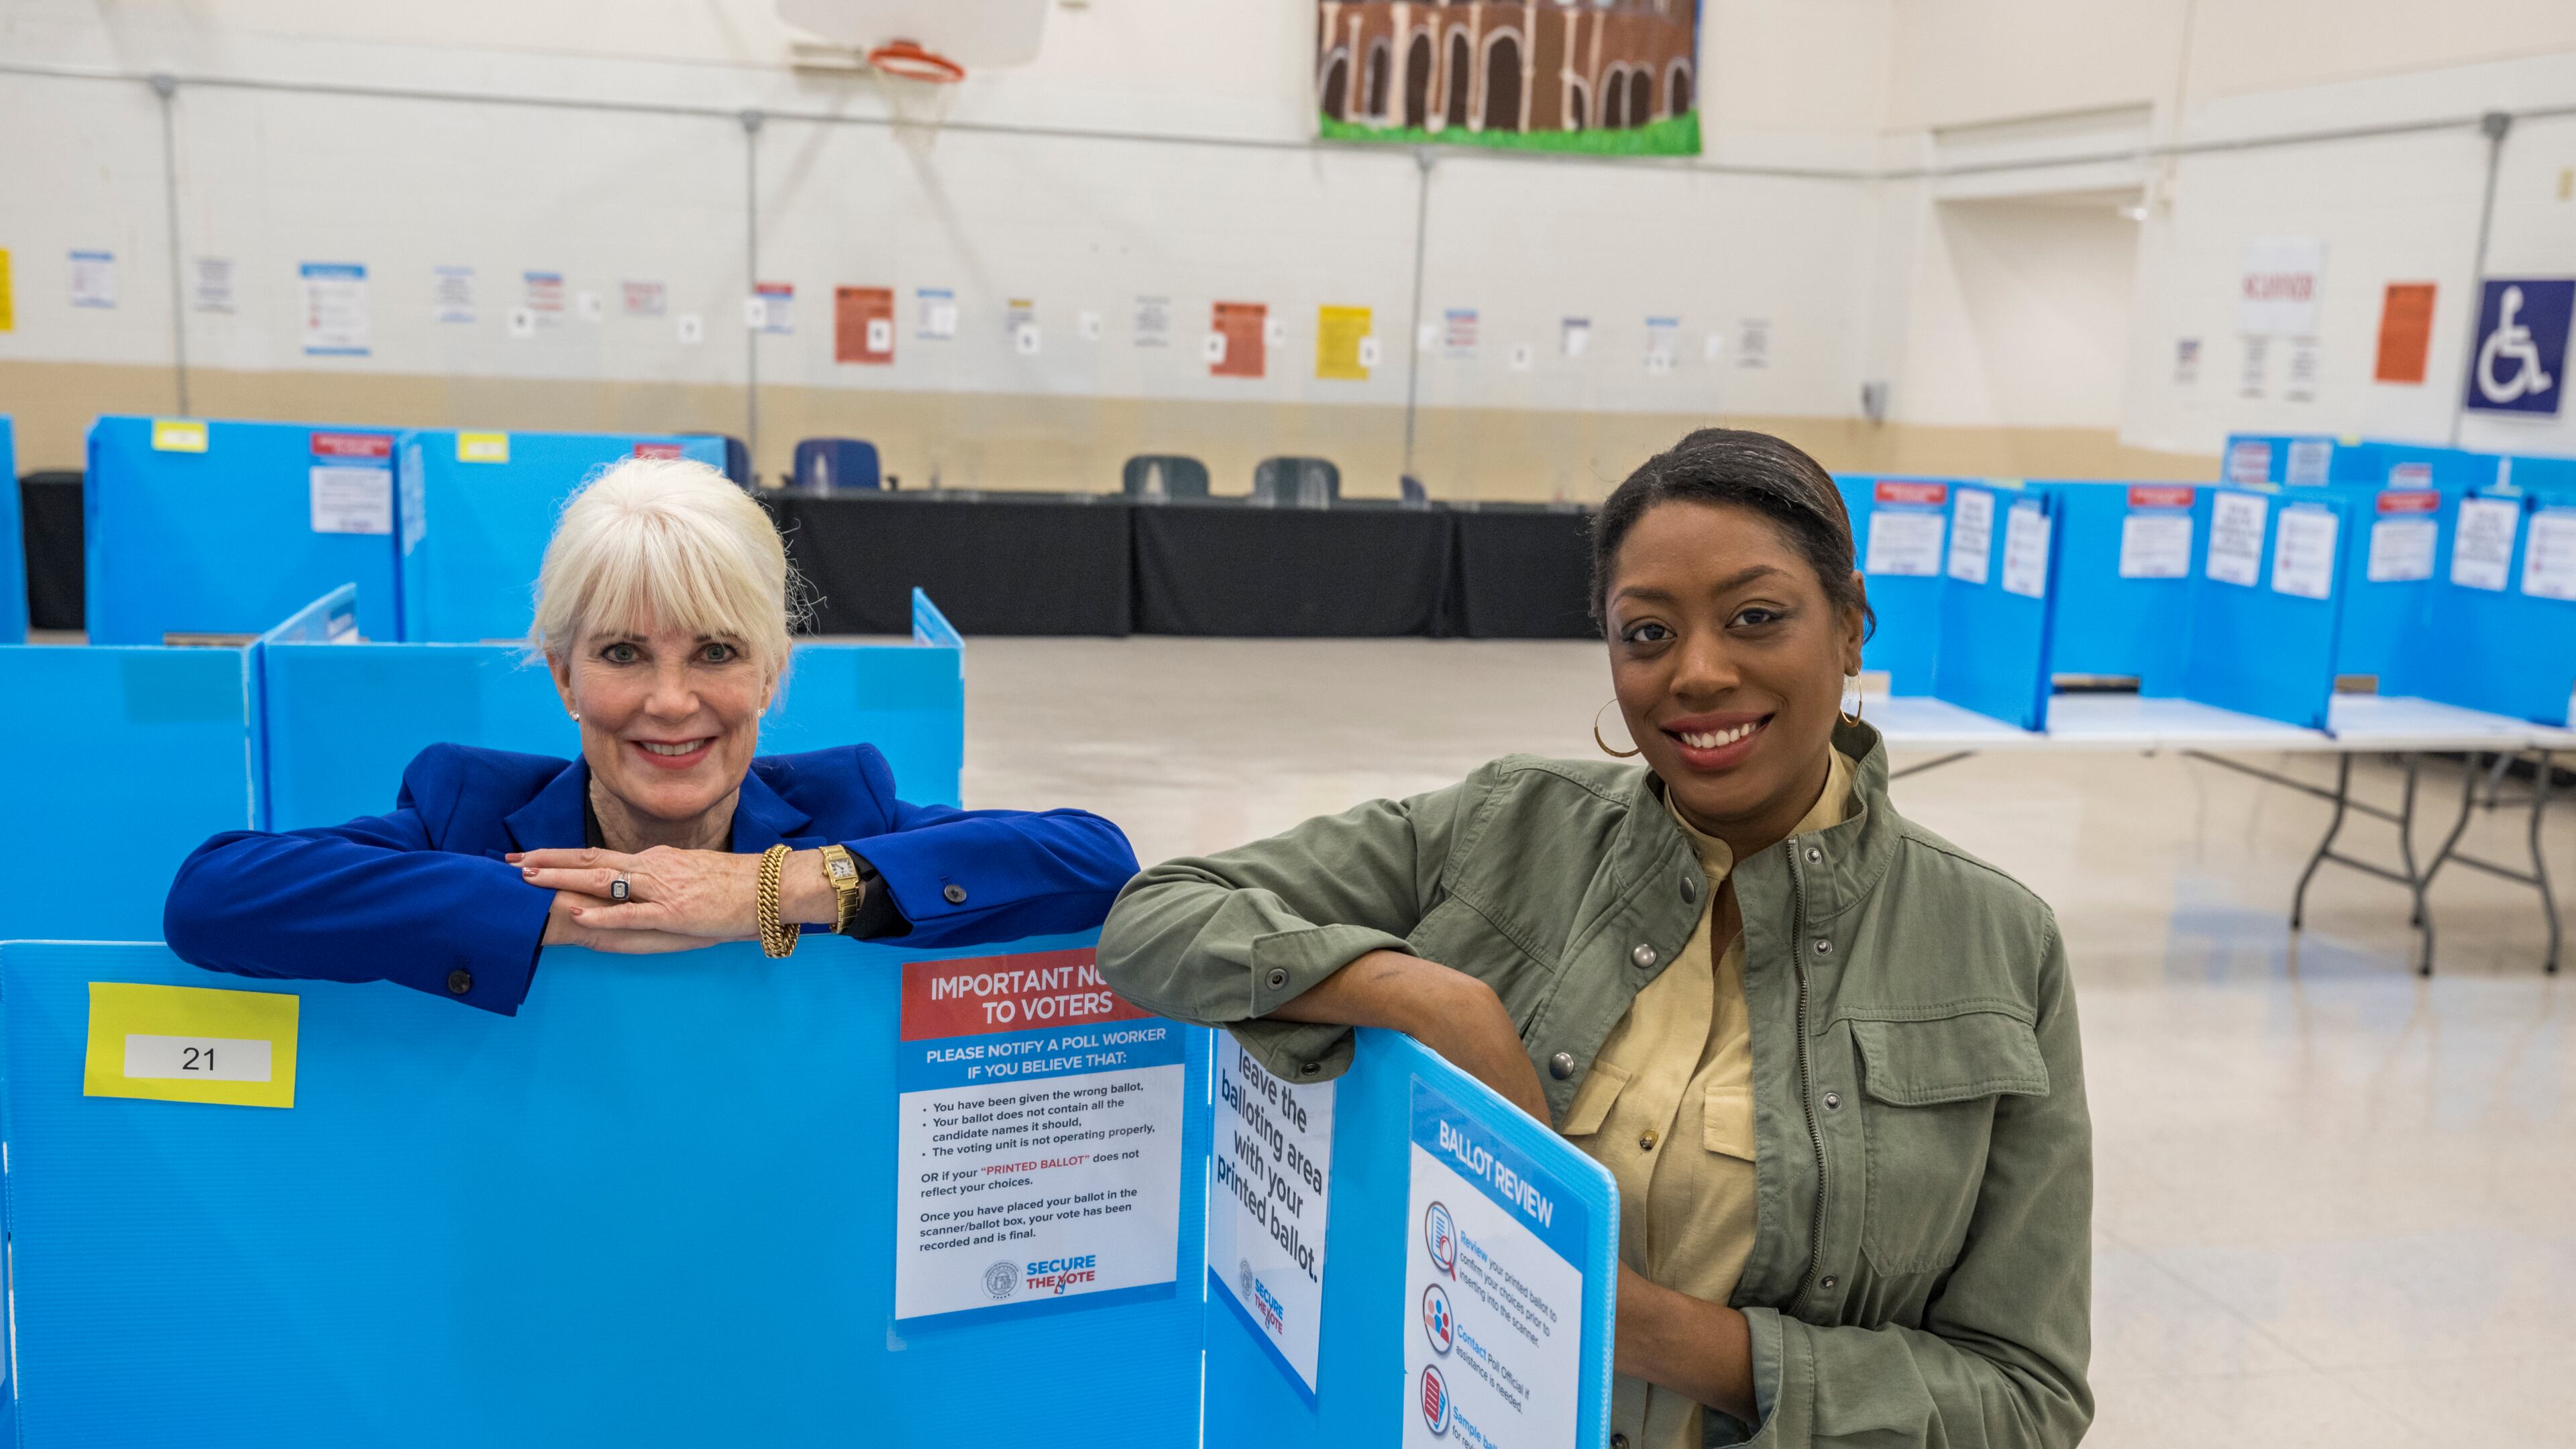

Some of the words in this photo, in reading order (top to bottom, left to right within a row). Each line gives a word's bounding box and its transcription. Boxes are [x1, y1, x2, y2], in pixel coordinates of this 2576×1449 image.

[931, 966, 1073, 1000] IMPORTANT
[982, 1000, 1016, 1024] TO
[1021, 991, 1113, 1020] VOTERS
[182, 1046, 215, 1071] 21
[926, 1046, 985, 1064] PLEASE
[988, 1040, 1044, 1058] NOTIFY
[1047, 1038, 1059, 1051] A
[1062, 1035, 1099, 1050] POLL
[1103, 1028, 1166, 1045] WORKER
[967, 1065, 981, 1079] IF
[984, 1062, 1018, 1077] YOU
[1022, 1056, 1082, 1073] BELIEVE
[1085, 1051, 1126, 1067] THAT:
[933, 1103, 954, 1112] You
[958, 1100, 985, 1110] have
[988, 1097, 1016, 1107] been
[1019, 1093, 1049, 1106] given
[1053, 1090, 1071, 1100] the
[1073, 1087, 1108, 1097] wrong
[1110, 1082, 1144, 1093] ballot,
[1239, 1046, 1277, 1105] leave
[1282, 1085, 1307, 1133] the
[932, 1128, 989, 1142] candidate
[991, 1125, 1028, 1136] names
[1032, 1122, 1039, 1131] it
[1042, 1117, 1081, 1130] should,
[933, 1118, 959, 1127] Your
[962, 1113, 994, 1124] ballot
[996, 1111, 1024, 1120] does
[1026, 1107, 1045, 1117] not
[1048, 1102, 1088, 1115] contain
[1091, 1099, 1104, 1110] all
[1107, 1099, 1124, 1108] the
[932, 1147, 953, 1157] The
[957, 1142, 992, 1154] voting
[996, 1139, 1017, 1150] unit
[1020, 1138, 1029, 1147] is
[1032, 1136, 1051, 1145] not
[1053, 1130, 1105, 1144] operating
[1108, 1124, 1155, 1138] properly,
[1222, 1068, 1283, 1163] balloting
[1287, 1143, 1322, 1195] area
[921, 1173, 938, 1183] OR
[942, 1171, 950, 1181] if
[952, 1170, 978, 1182] your
[981, 1161, 1037, 1175] “PRINTED
[1040, 1155, 1089, 1169] BALLOT”
[1093, 1153, 1119, 1163] does
[1122, 1149, 1139, 1159] not
[1234, 1130, 1263, 1181] with
[1267, 1165, 1303, 1218] your
[1439, 1119, 1493, 1181] BALLOT
[1495, 1161, 1553, 1229] REVIEW
[921, 1185, 957, 1197] reflect
[960, 1183, 985, 1195] your
[988, 1178, 1033, 1189] choices.
[920, 1212, 950, 1222] Once
[953, 1210, 973, 1221] you
[977, 1205, 1004, 1216] have
[1007, 1199, 1044, 1214] placed
[1046, 1197, 1071, 1209] your
[1074, 1192, 1105, 1203] ballot
[1108, 1190, 1117, 1199] in
[1120, 1189, 1138, 1198] the
[920, 1219, 1000, 1237] scanner/ballot
[1003, 1218, 1026, 1226] box,
[1028, 1214, 1054, 1226] your
[1056, 1210, 1080, 1220] vote
[1083, 1208, 1102, 1216] has
[1105, 1204, 1132, 1214] been
[1218, 1154, 1267, 1226] printed
[1271, 1205, 1318, 1283] ballot.
[920, 1236, 970, 1252] recorded
[973, 1233, 994, 1245] and
[998, 1232, 1006, 1242] is
[1009, 1228, 1036, 1240] final.
[1027, 1255, 1095, 1275] SECURE
[1460, 1230, 1488, 1263] Review
[1489, 1258, 1503, 1276] your
[1505, 1272, 1528, 1298] printed
[1529, 1290, 1548, 1317] ballot
[1550, 1309, 1557, 1323] to
[1255, 1278, 1283, 1321] SECURE
[1459, 1268, 1486, 1302] inserting
[1487, 1292, 1499, 1311] into
[1500, 1305, 1510, 1322] the
[1512, 1317, 1540, 1348] scanner.
[1460, 1252, 1483, 1277] confirm
[1484, 1273, 1499, 1291] your
[1499, 1287, 1524, 1314] choices
[1525, 1309, 1542, 1330] prior
[1543, 1323, 1550, 1337] to
[1457, 1324, 1487, 1361] Contact
[1488, 1353, 1499, 1373] Poll
[1501, 1366, 1523, 1395] Official
[1525, 1387, 1529, 1401] if
[1456, 1345, 1488, 1381] assistance
[1489, 1374, 1495, 1388] is
[1496, 1383, 1523, 1415] needed.
[1454, 1406, 1481, 1442] Sample
